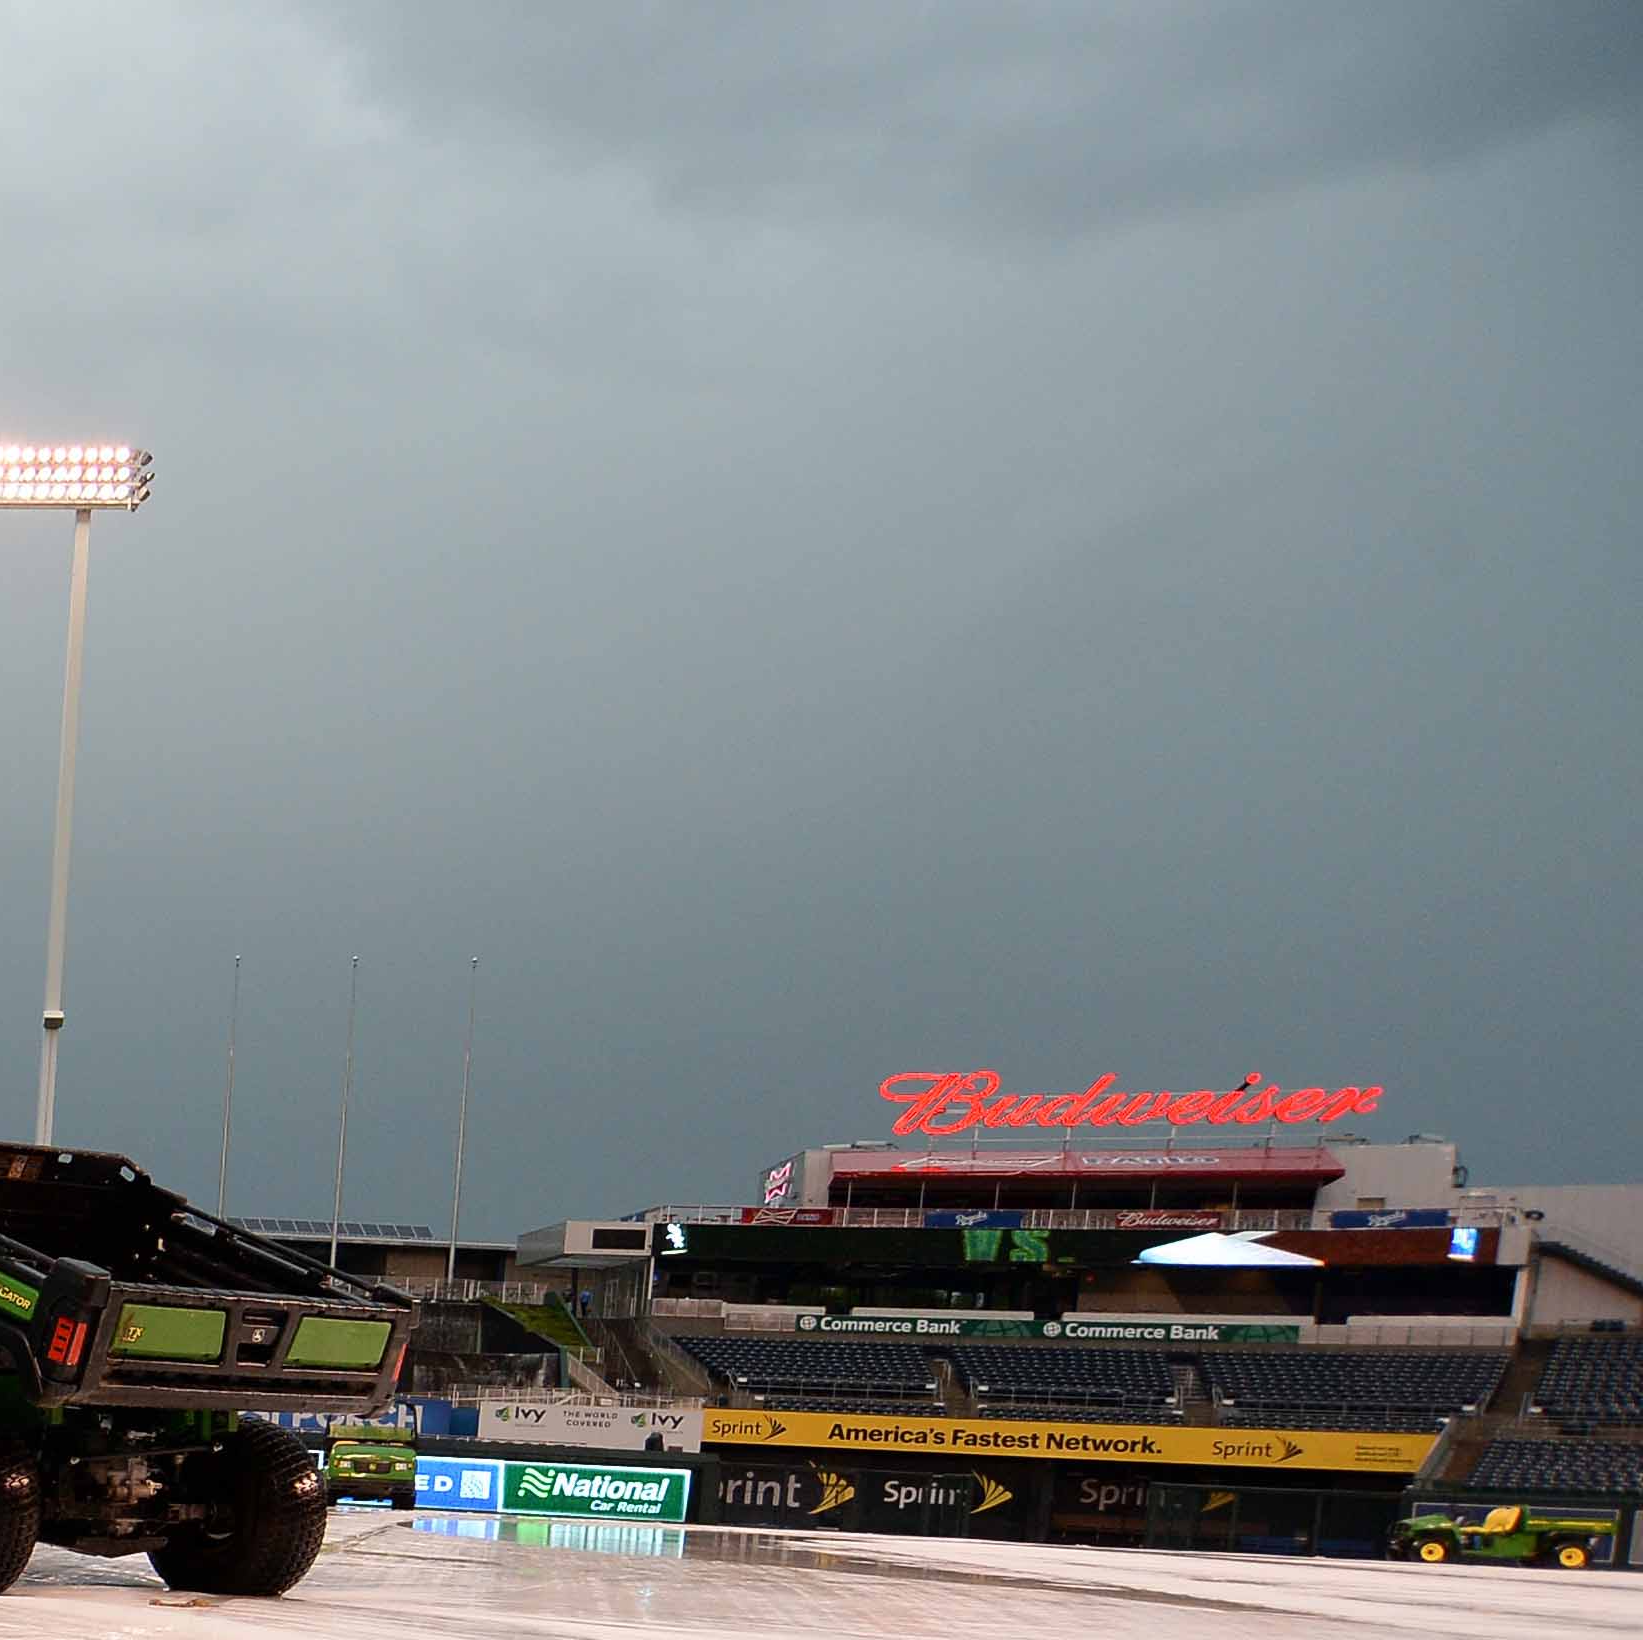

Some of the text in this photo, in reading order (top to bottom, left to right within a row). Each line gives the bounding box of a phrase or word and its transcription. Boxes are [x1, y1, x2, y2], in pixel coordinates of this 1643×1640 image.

[878, 1069, 1385, 1136] Budweiser
[1116, 1209, 1218, 1229] Budweiser
[820, 1316, 962, 1335] Commerce Bank
[1065, 1322, 1220, 1342] Commerce Bank
[515, 1405, 547, 1423] Ivy
[564, 1409, 619, 1420] THE WORLD
[566, 1419, 612, 1428] COVERED
[651, 1412, 685, 1430] Ivy
[712, 1419, 1273, 1460] Sprint America's Fastest Network. Sprint
[552, 1470, 671, 1501] National
[589, 1499, 662, 1515] Car Rental
